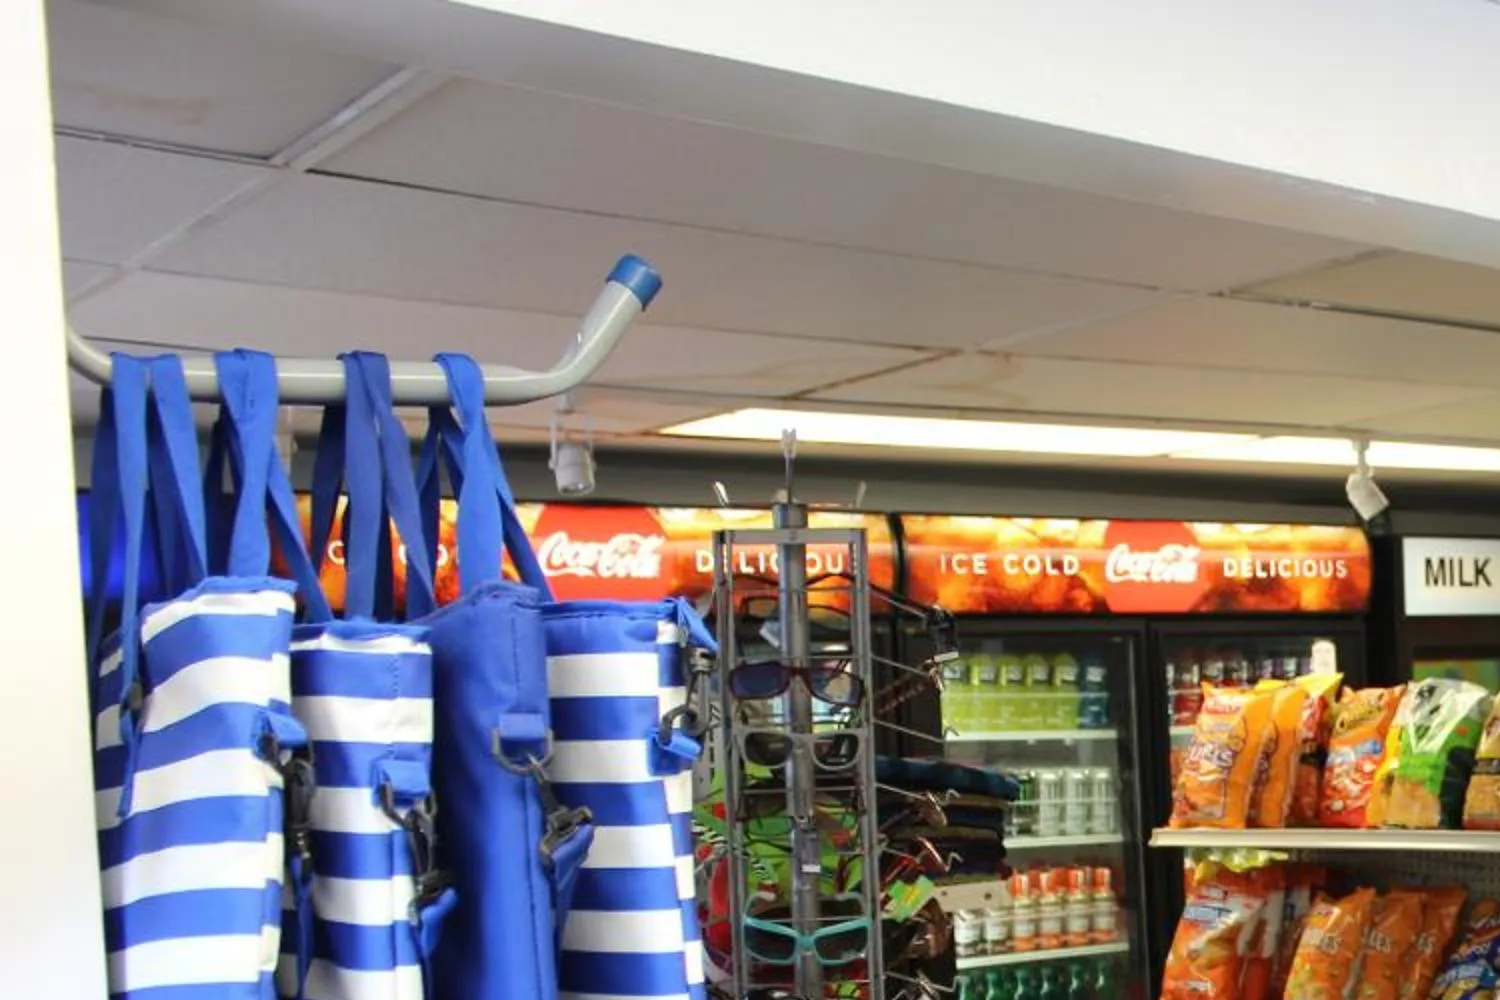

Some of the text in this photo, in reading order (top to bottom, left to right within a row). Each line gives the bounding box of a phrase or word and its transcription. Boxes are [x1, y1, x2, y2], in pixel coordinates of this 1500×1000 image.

[540, 531, 665, 579] Coca-Cola
[695, 548, 863, 576] DLICOU
[940, 556, 1081, 577] ICE COLD
[1105, 543, 1200, 585] Coca-Cola
[1222, 557, 1349, 579] DELICIOUS
[1424, 556, 1491, 588] MILK
